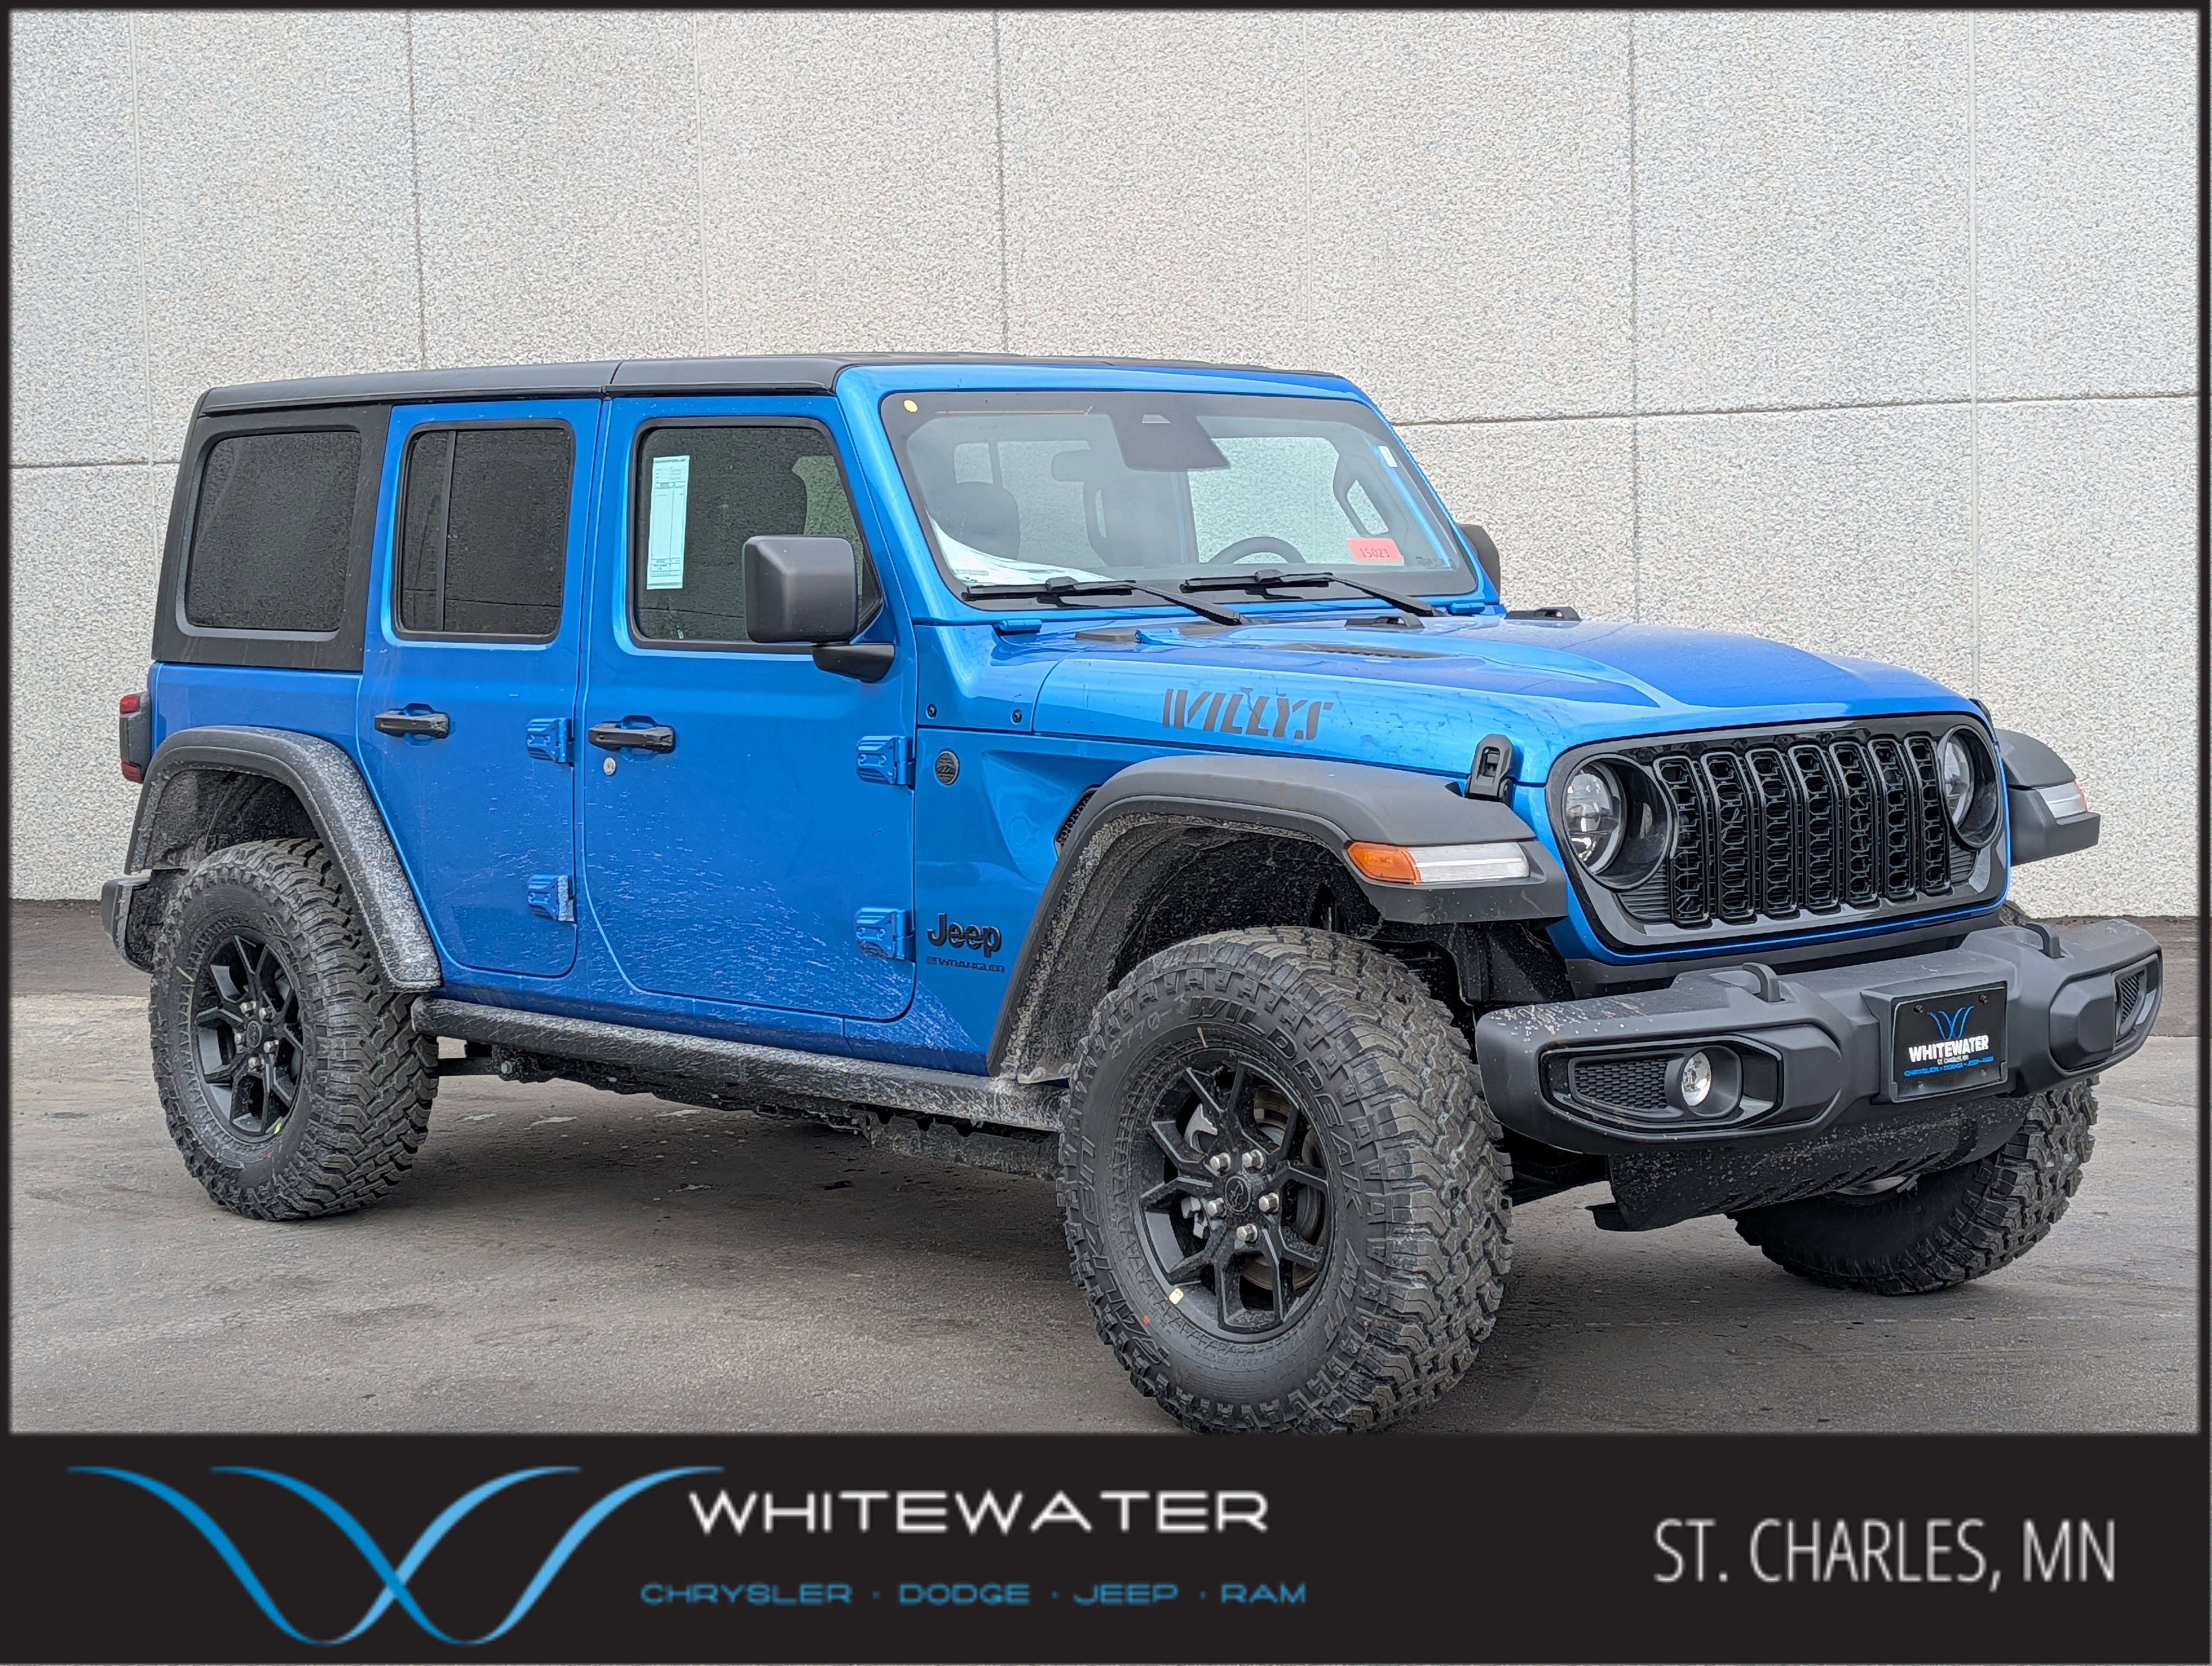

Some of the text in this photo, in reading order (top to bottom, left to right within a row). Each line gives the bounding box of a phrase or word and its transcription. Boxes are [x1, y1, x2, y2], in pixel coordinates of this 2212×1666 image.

[1162, 688, 1334, 740] WILLYS
[927, 912, 1002, 958] Jeep
[1908, 1034, 1990, 1063] WHITEWATER
